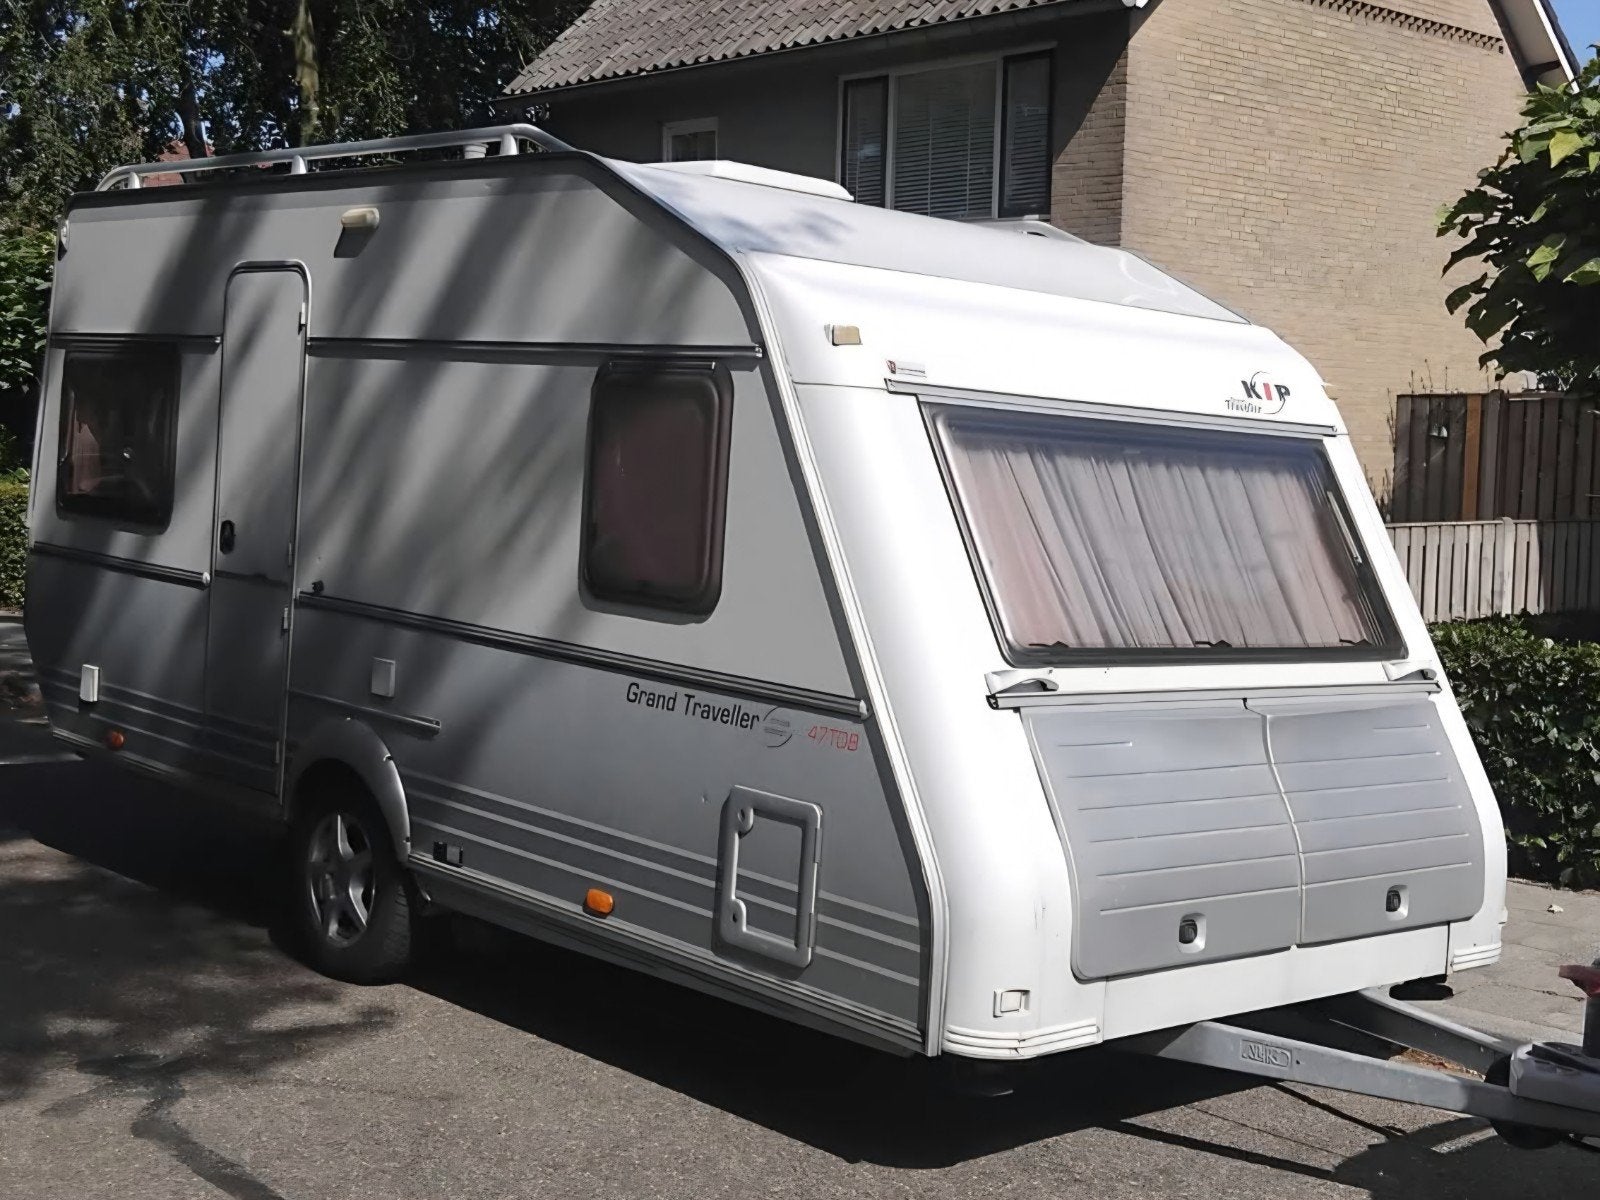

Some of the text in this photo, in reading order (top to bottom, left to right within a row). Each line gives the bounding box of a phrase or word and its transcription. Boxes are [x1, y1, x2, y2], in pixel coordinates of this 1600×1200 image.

[1240, 379, 1291, 402] KIP
[626, 681, 678, 712] Grand
[684, 693, 760, 730] Traveller
